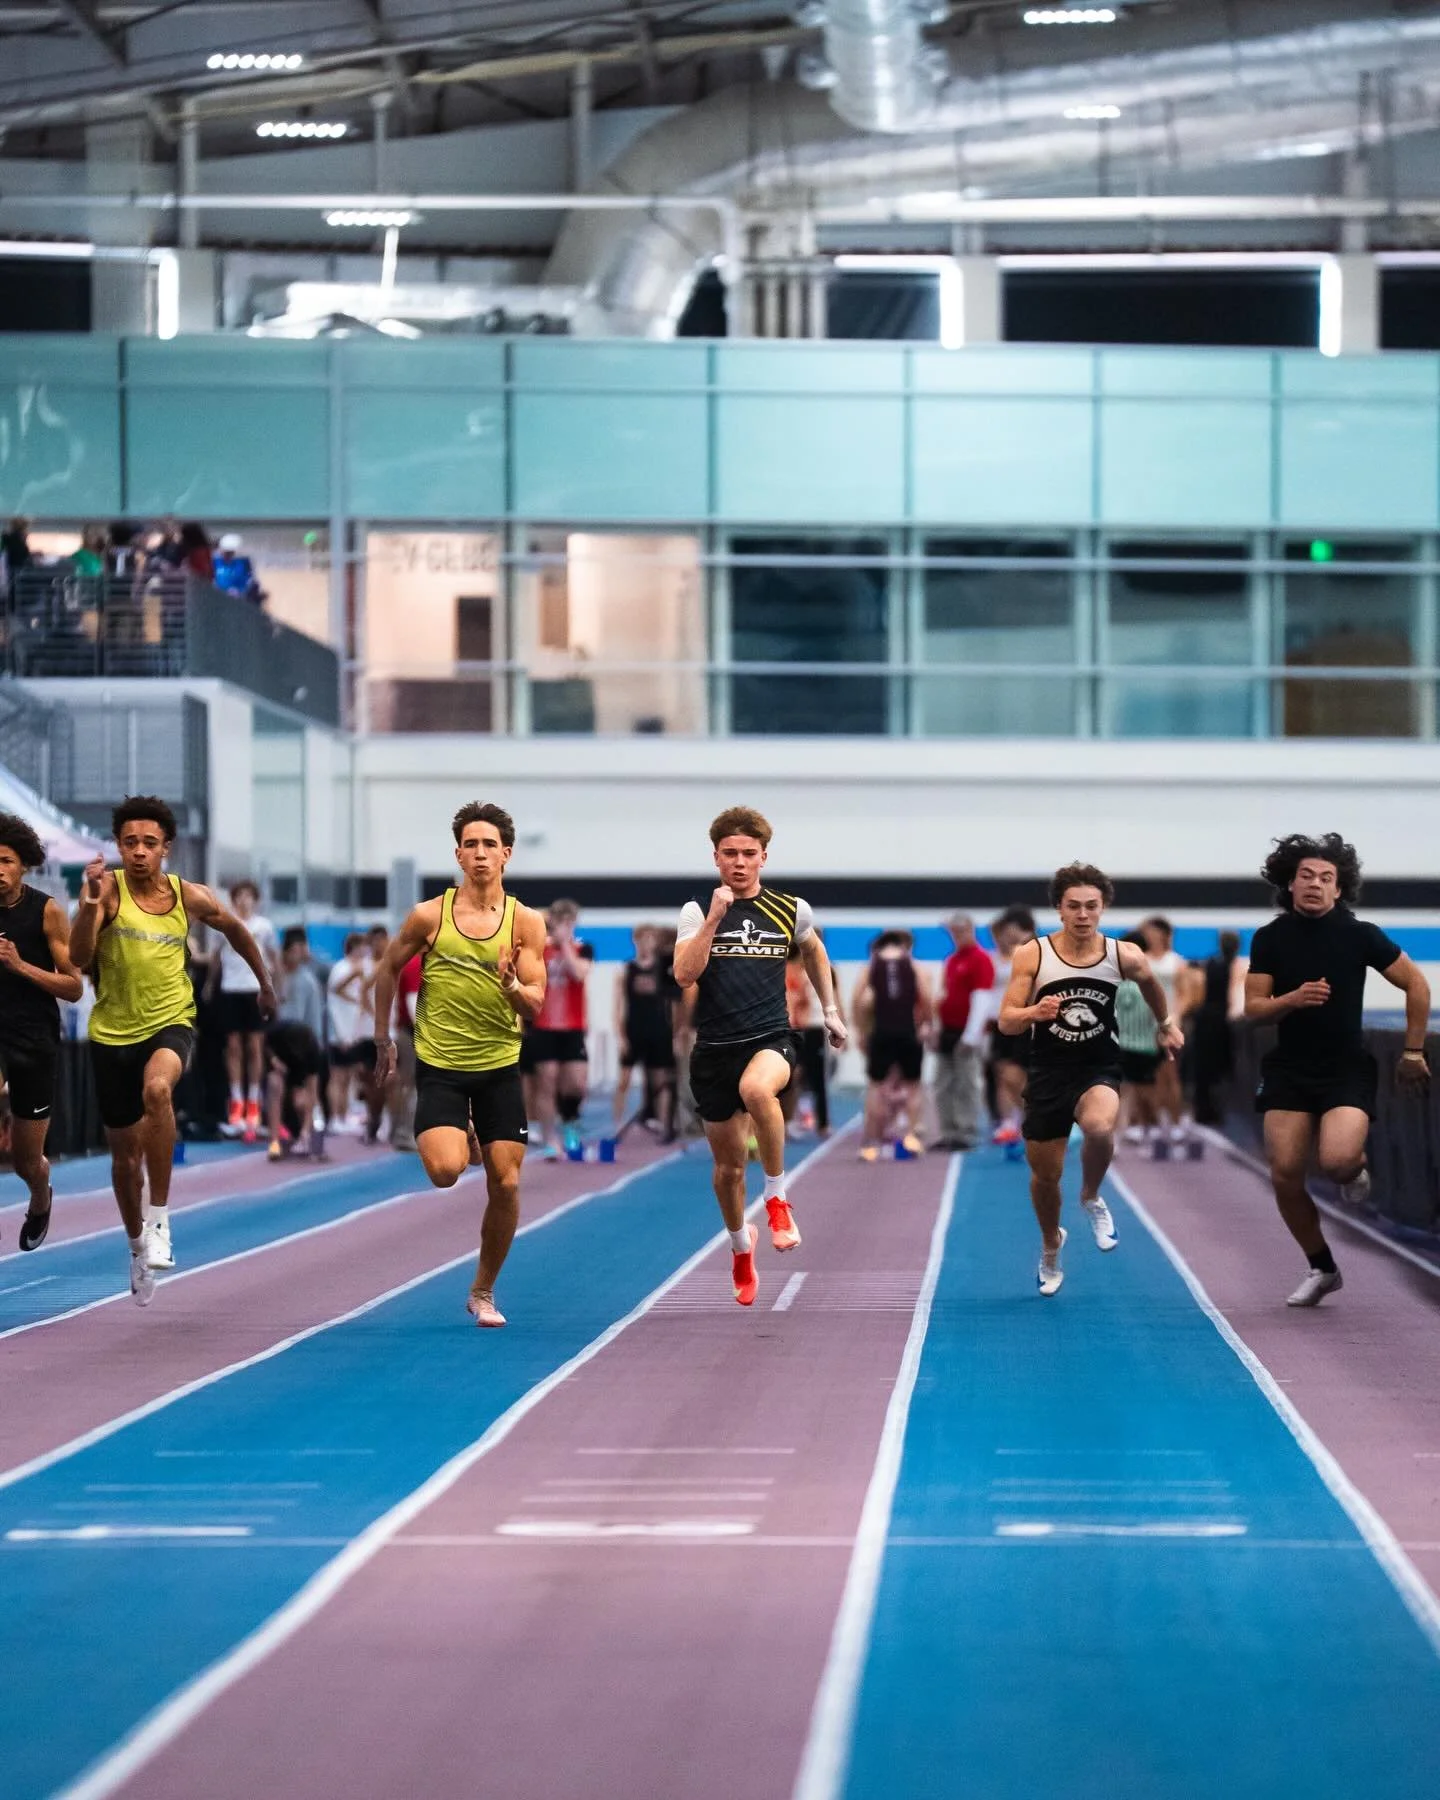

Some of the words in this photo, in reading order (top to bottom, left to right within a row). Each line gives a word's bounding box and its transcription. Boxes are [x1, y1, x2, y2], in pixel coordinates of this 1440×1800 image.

[711, 945, 785, 955] CAMP
[1054, 988, 1110, 1007] ILLCREEK
[1048, 1022, 1105, 1042] MUSTANGS
